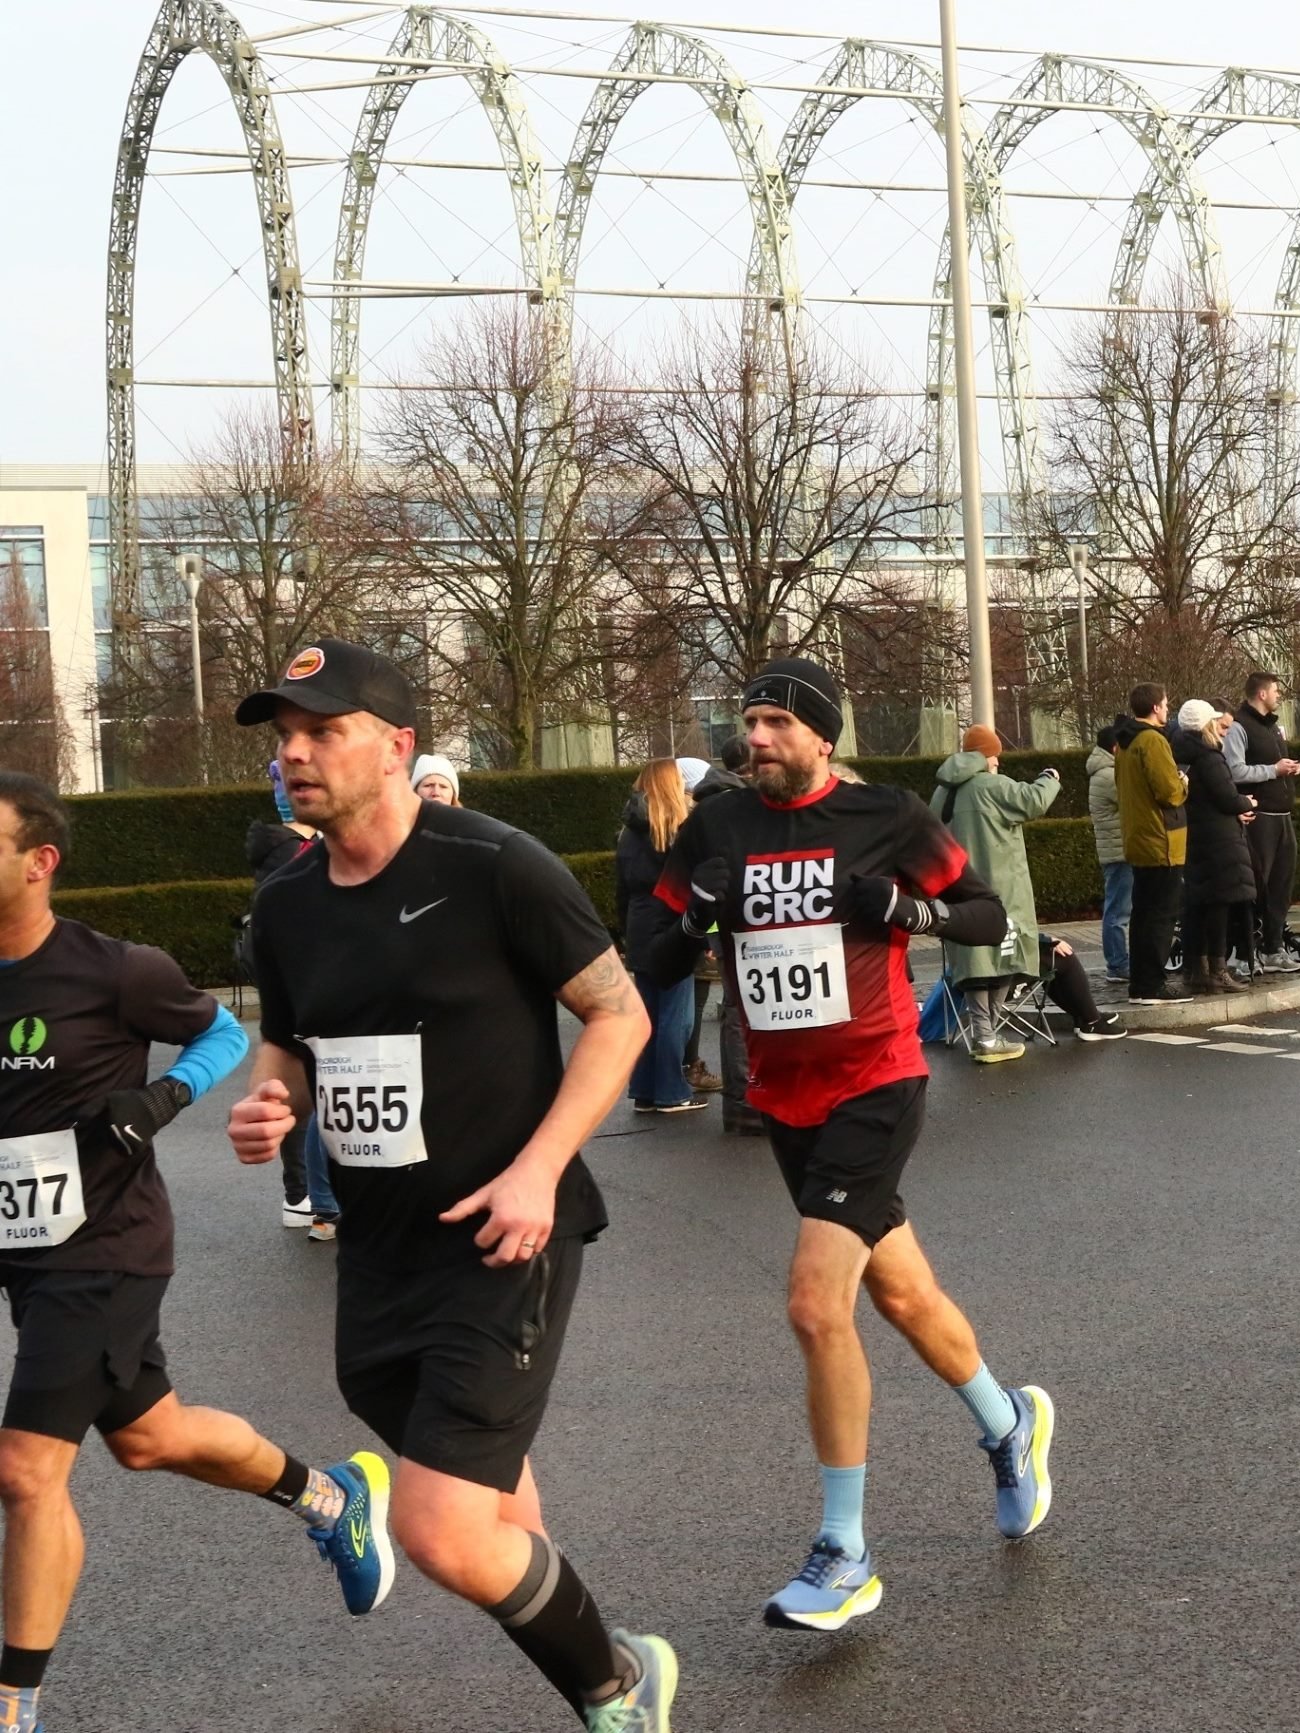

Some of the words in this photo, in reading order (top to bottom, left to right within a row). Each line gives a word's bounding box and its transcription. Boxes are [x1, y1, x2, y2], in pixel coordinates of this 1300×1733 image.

[743, 857, 834, 894] RUN
[743, 887, 833, 926] CRC
[773, 949, 794, 958] HALF
[747, 962, 831, 1004] 3191
[771, 1008, 813, 1020] FLUOR
[340, 1065, 363, 1074] HALF
[319, 1085, 408, 1133] 2555
[341, 1144, 381, 1156] FLUOR
[6, 1226, 48, 1239] FLUOR
